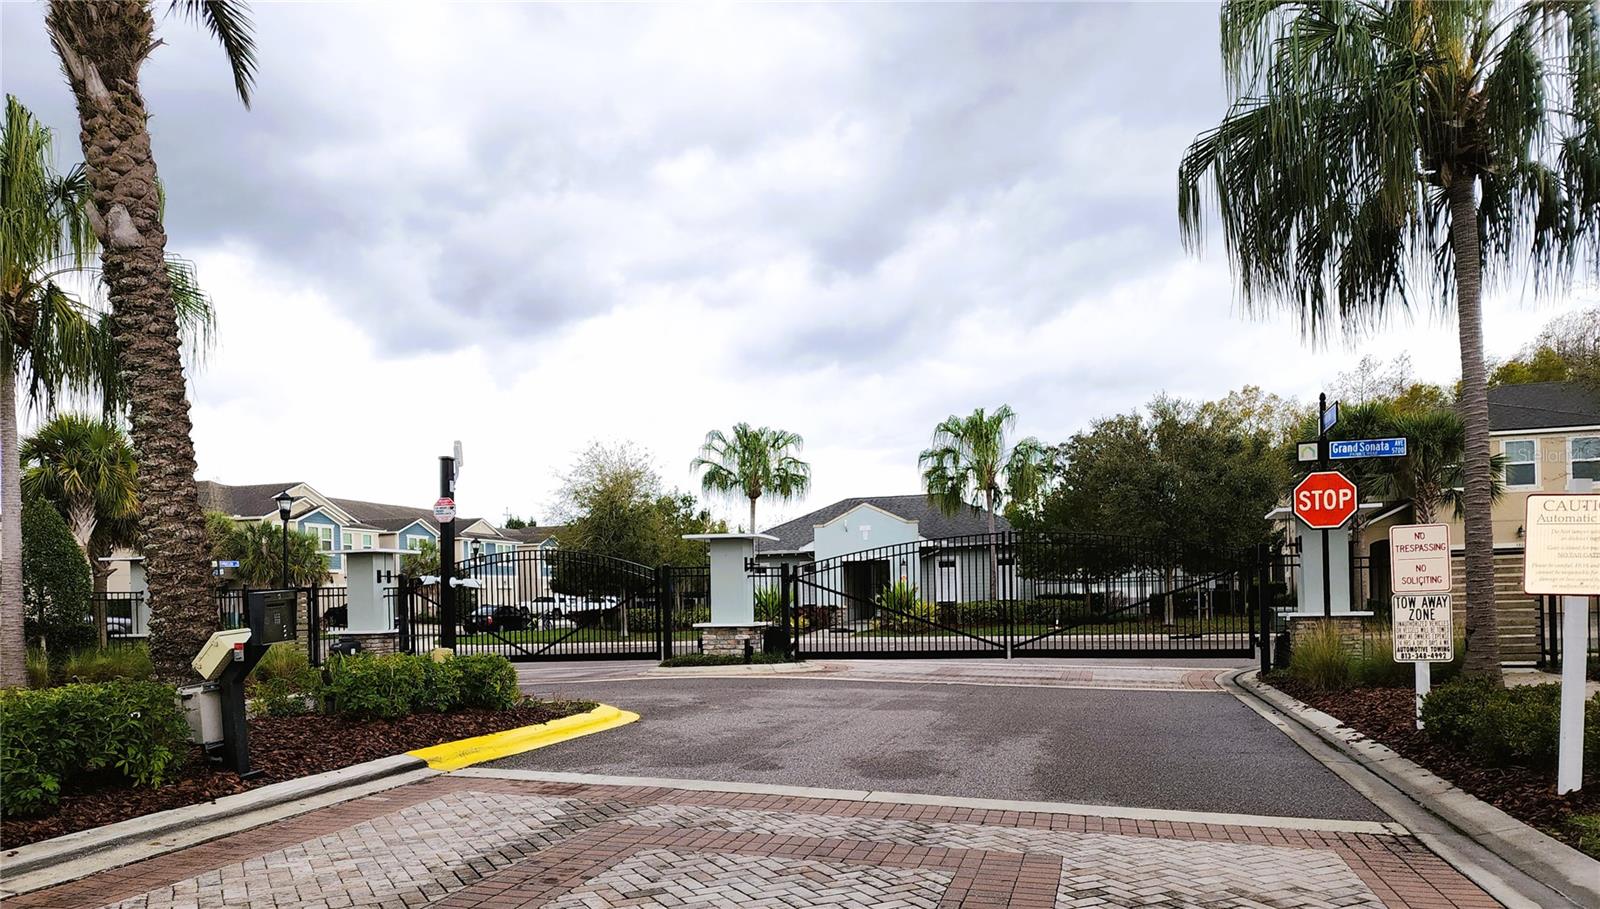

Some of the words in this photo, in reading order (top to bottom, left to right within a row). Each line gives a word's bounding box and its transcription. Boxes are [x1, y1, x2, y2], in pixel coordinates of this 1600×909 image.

[1332, 443, 1358, 454] Grand
[1359, 441, 1389, 453] Sonata
[1299, 488, 1352, 511] STOP
[1543, 499, 1600, 512] CAUTI
[1537, 514, 1597, 523] Automatic
[1414, 532, 1425, 540] NO
[1395, 543, 1446, 553] TRESPASSING
[1415, 564, 1427, 572] NO
[1401, 576, 1443, 585] SOLICITING
[1396, 597, 1416, 609] TOW
[1421, 596, 1448, 608] AWAY
[1408, 608, 1436, 621] ZONE
